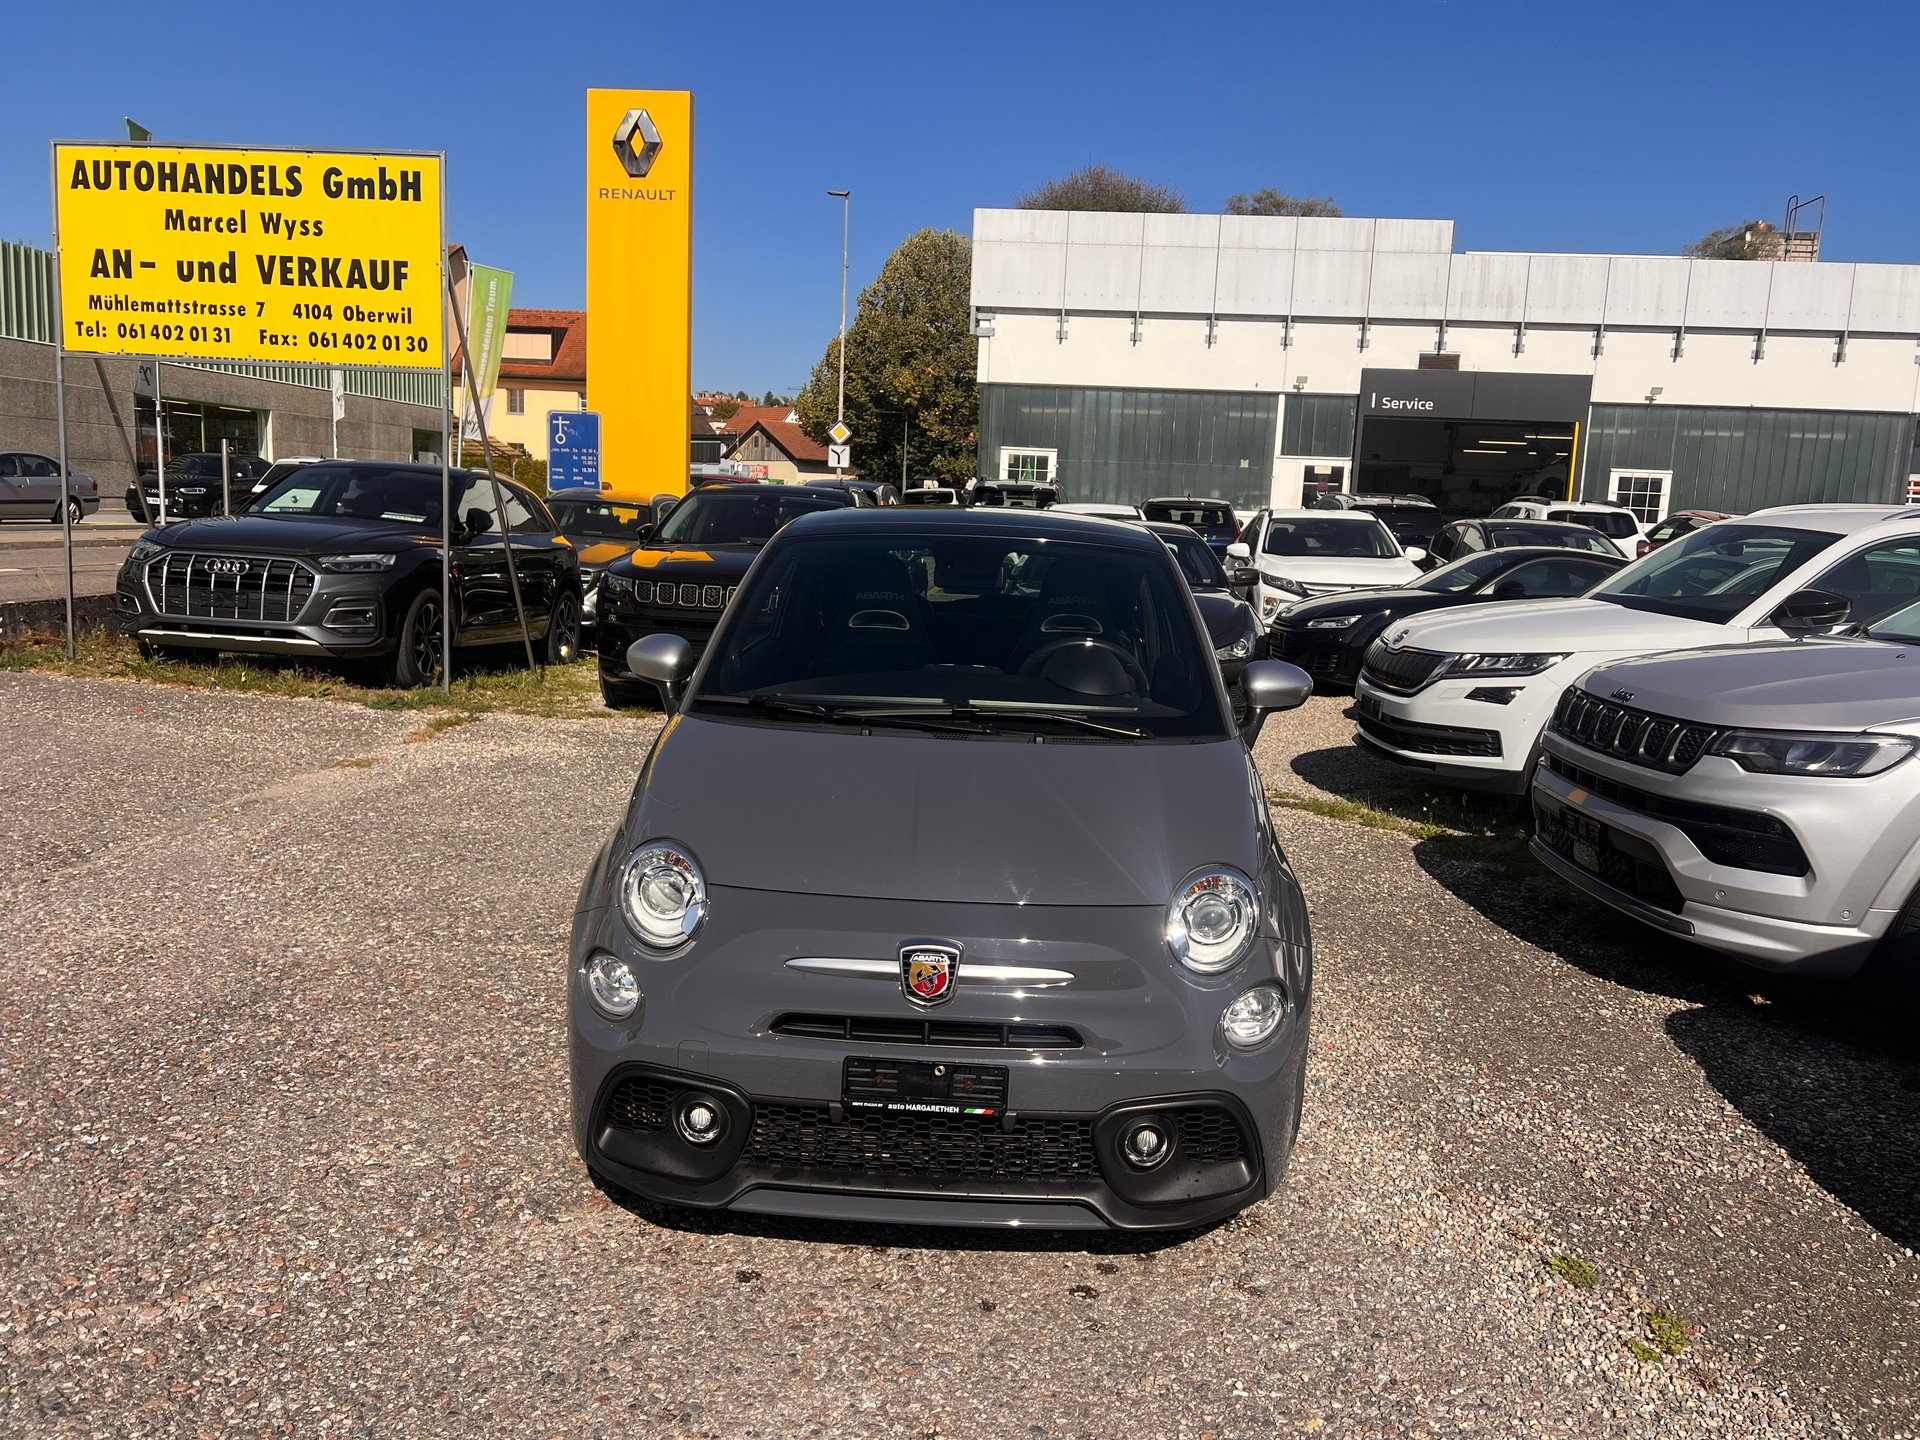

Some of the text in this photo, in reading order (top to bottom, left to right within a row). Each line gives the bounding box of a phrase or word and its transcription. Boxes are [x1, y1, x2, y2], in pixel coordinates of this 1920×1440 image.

[70, 159, 422, 202] AUTOHANDELS GmbH
[599, 187, 676, 201] RENAULT
[164, 208, 324, 241] Marcel Wyss
[90, 248, 409, 291] AN- und VERKAUF
[88, 293, 412, 325] Mühlemattstrasse 7 4104 Oberwil
[485, 278, 498, 313] Traum.
[75, 320, 107, 338] Tel:
[259, 329, 298, 347] Fax:
[482, 316, 494, 350] deinen
[1382, 397, 1434, 410] Service
[855, 591, 905, 601] ABARTH
[912, 955, 948, 963] ABARTH
[905, 1103, 960, 1114] MARGARETHEN
